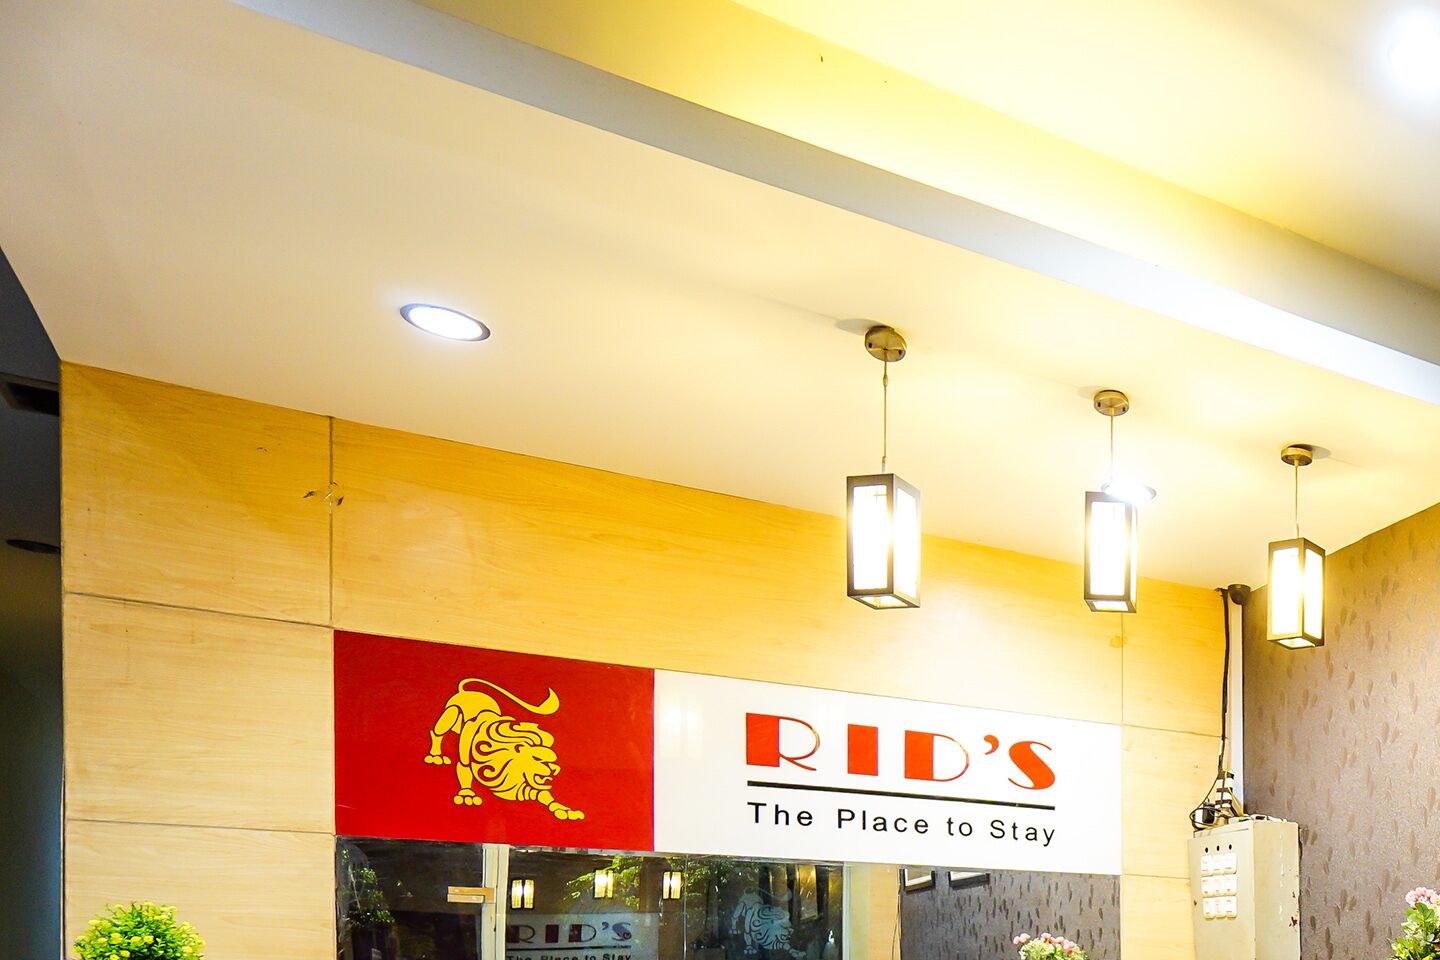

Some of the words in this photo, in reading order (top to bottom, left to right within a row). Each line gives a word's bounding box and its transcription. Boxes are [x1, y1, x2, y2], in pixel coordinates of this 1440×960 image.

[745, 711, 1056, 791] RID'S
[747, 801, 813, 827] The
[837, 807, 929, 834] Place
[947, 816, 973, 837] to
[989, 819, 1056, 847] Stay
